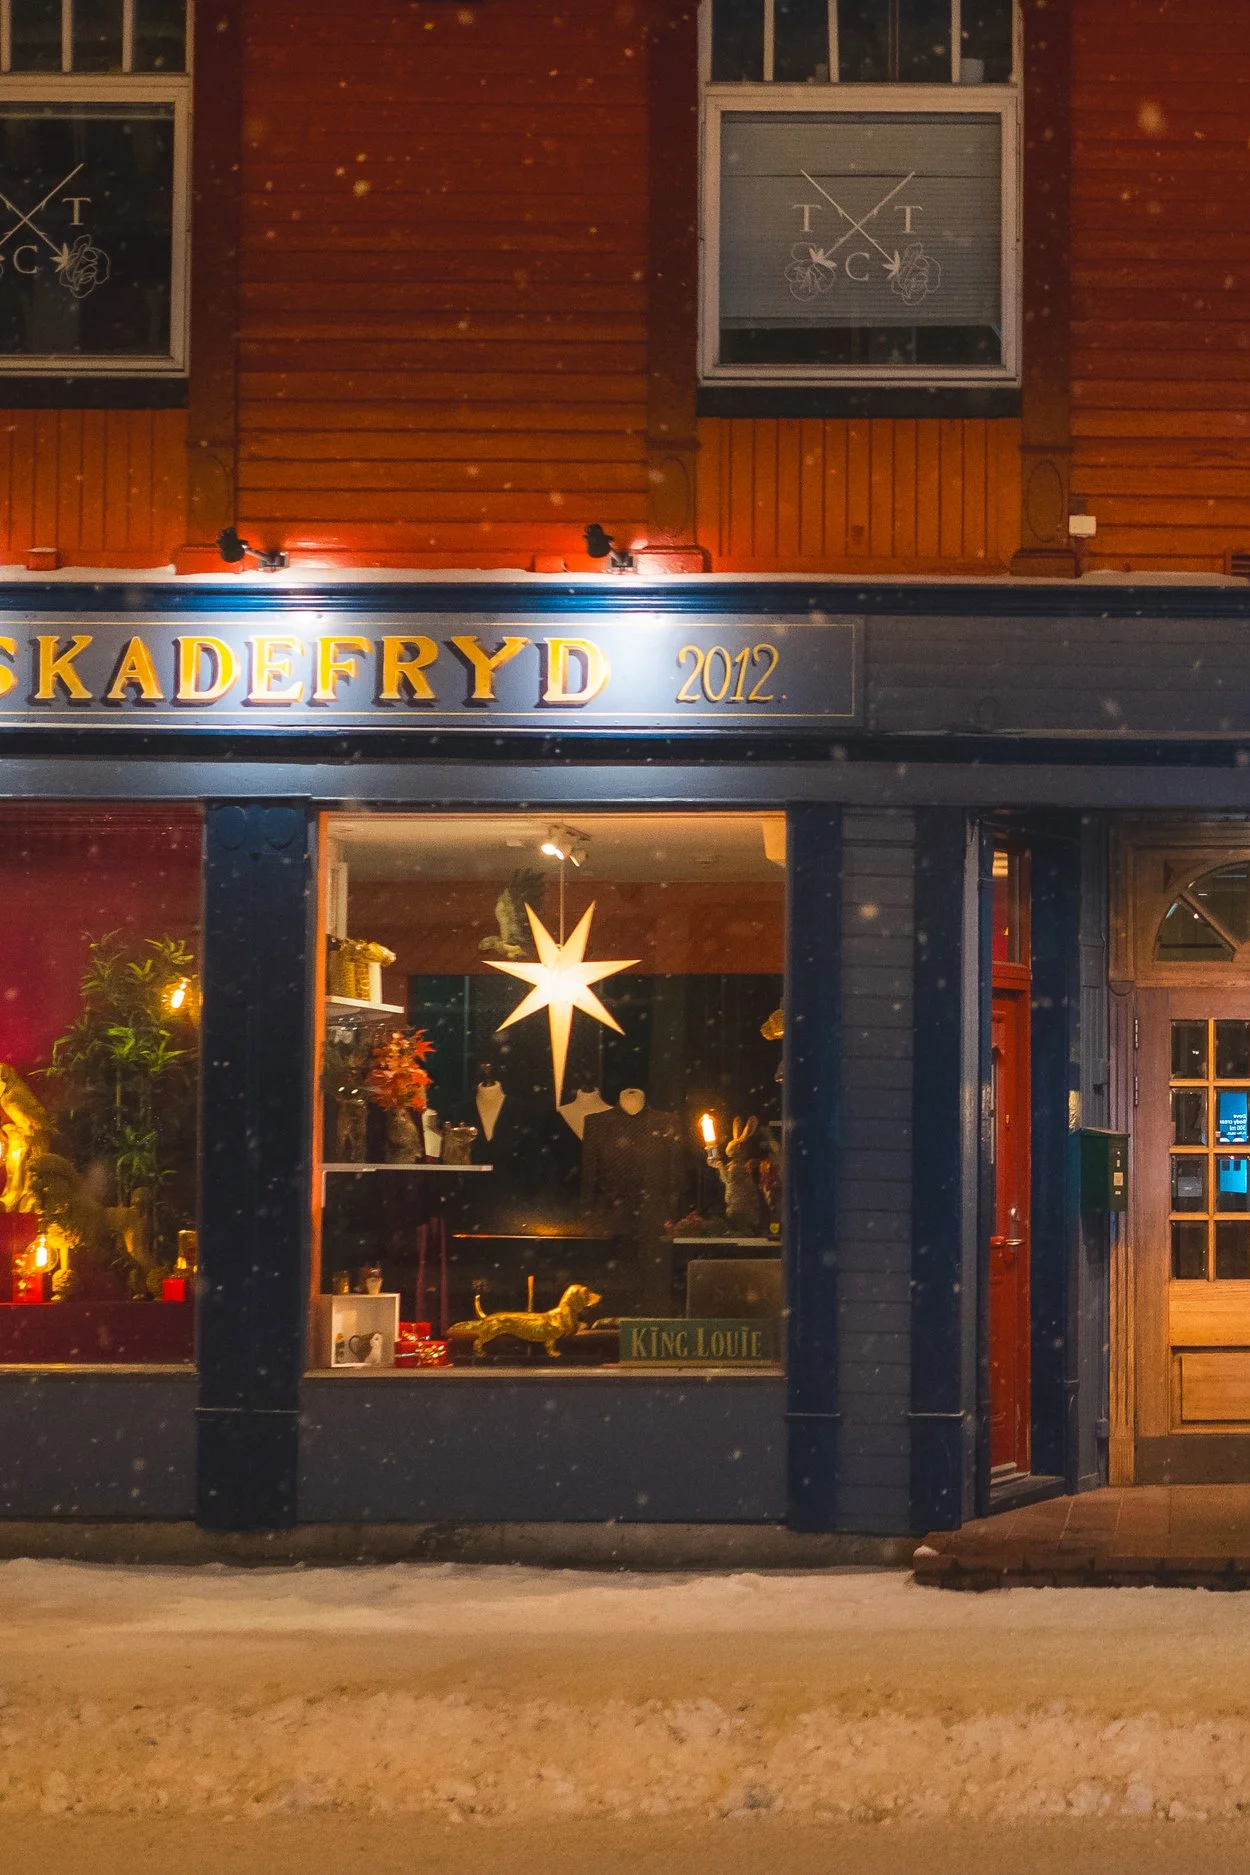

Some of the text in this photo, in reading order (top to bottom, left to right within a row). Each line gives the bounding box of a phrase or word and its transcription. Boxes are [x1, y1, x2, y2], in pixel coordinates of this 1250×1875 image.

[62, 197, 91, 226] T
[792, 203, 923, 234] T T
[13, 245, 39, 274] C
[845, 251, 870, 281] C
